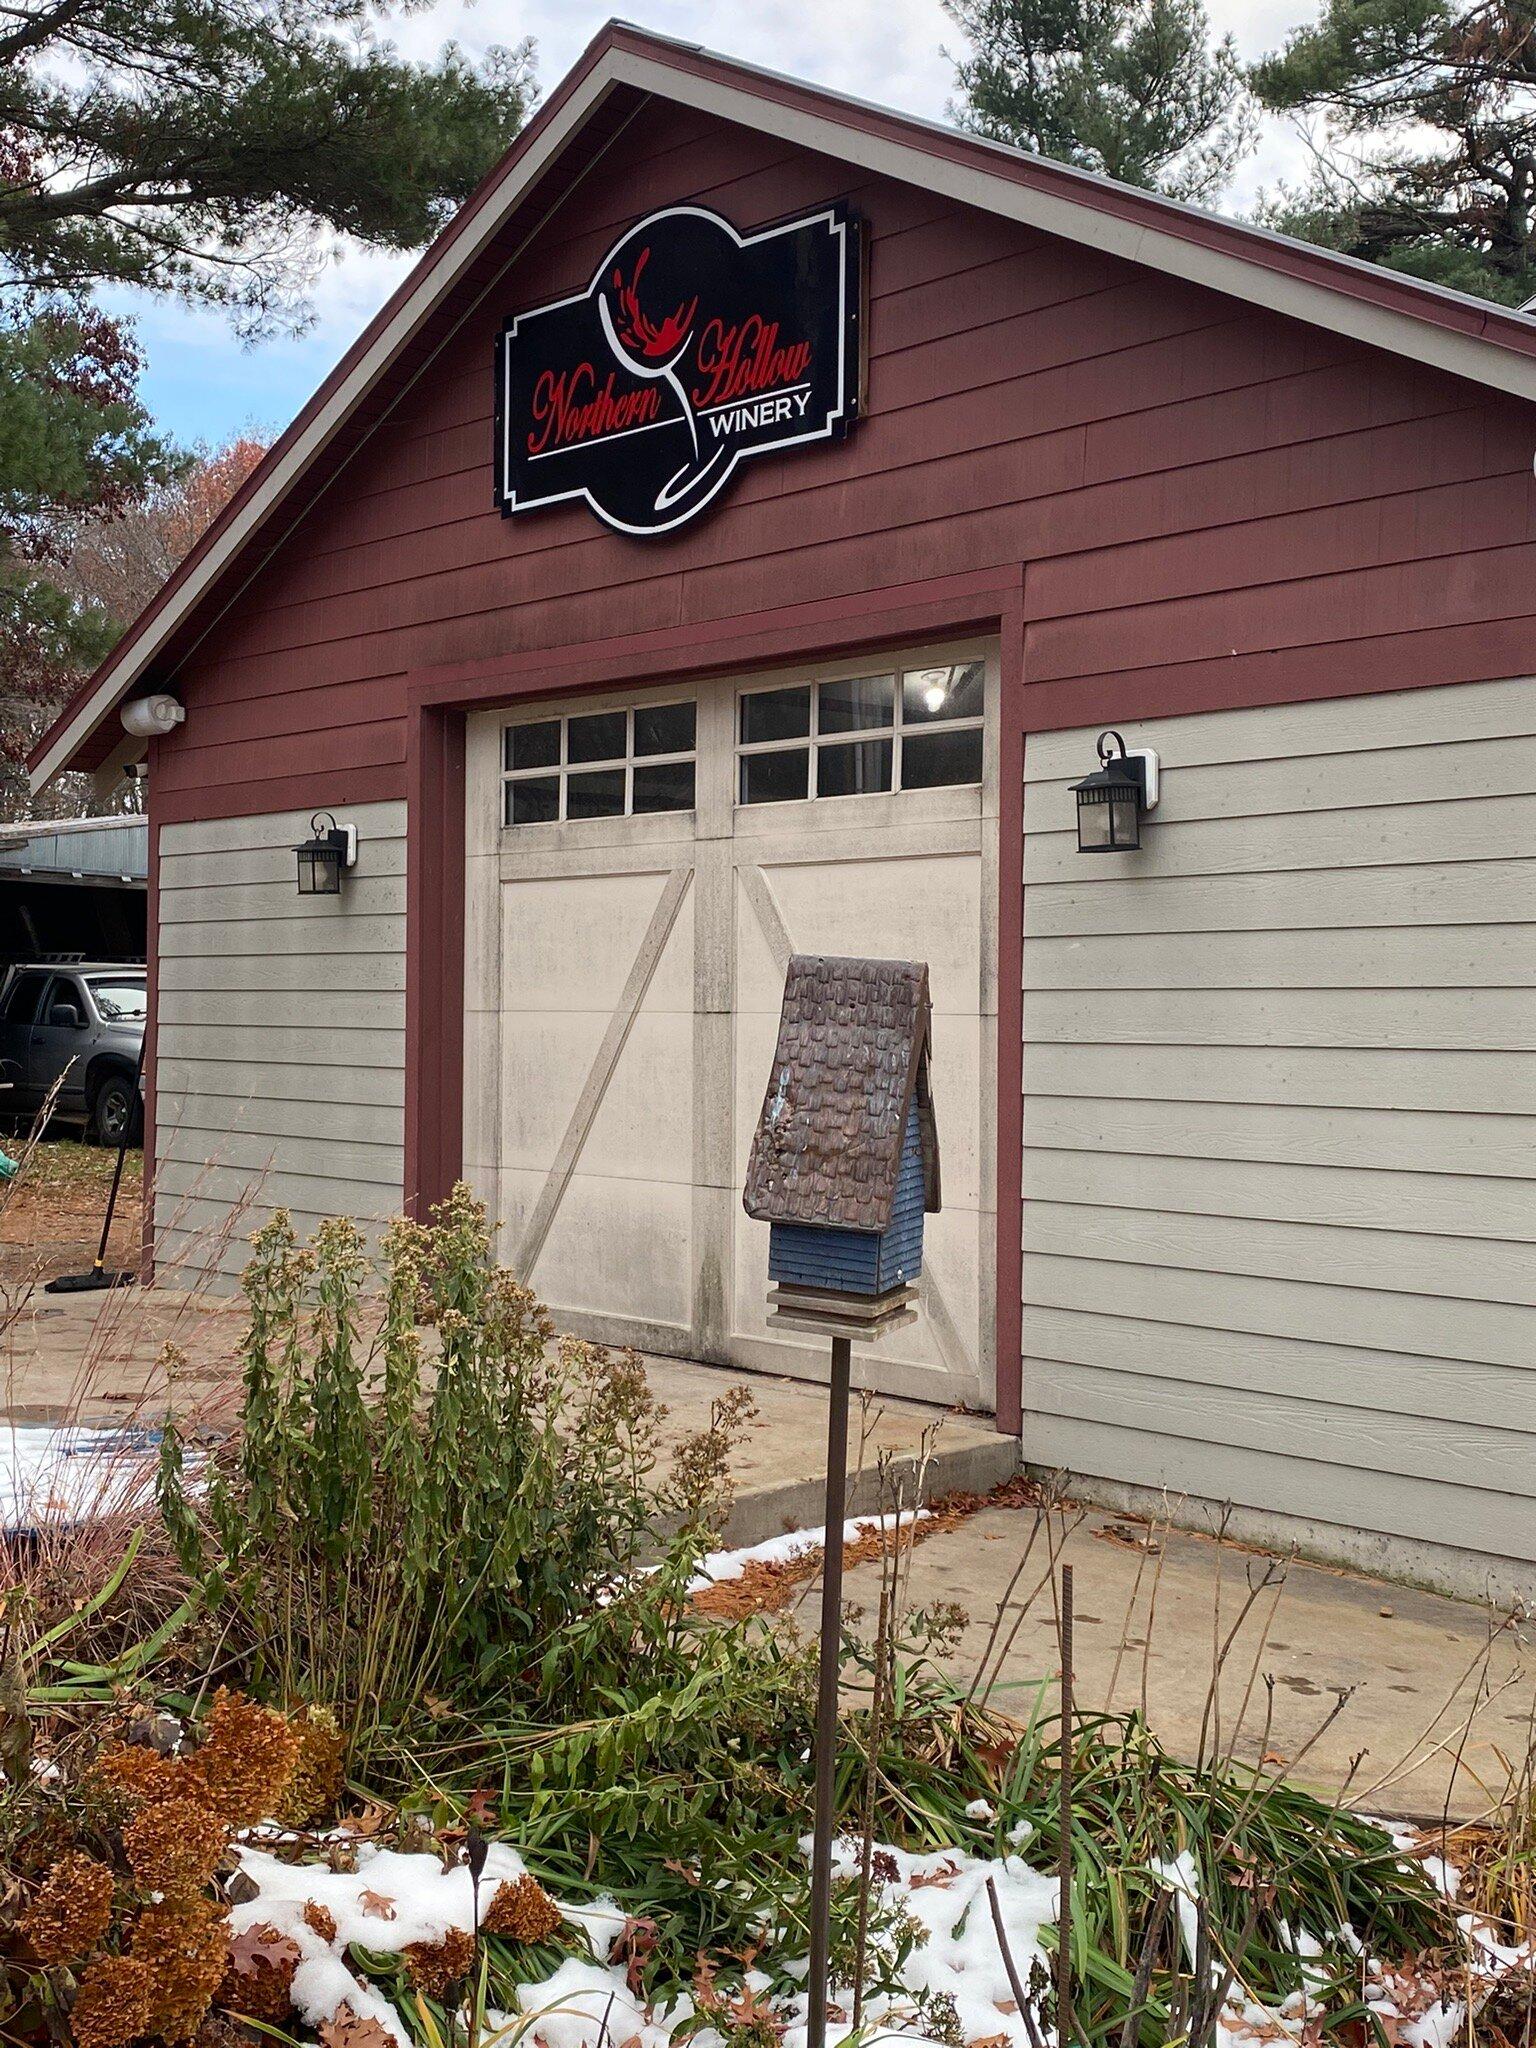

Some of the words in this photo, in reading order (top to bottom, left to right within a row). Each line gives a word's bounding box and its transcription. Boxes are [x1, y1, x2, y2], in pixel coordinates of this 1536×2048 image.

[527, 362, 661, 453] Northern
[692, 314, 812, 407] Hollow
[709, 391, 812, 437] WINERY
